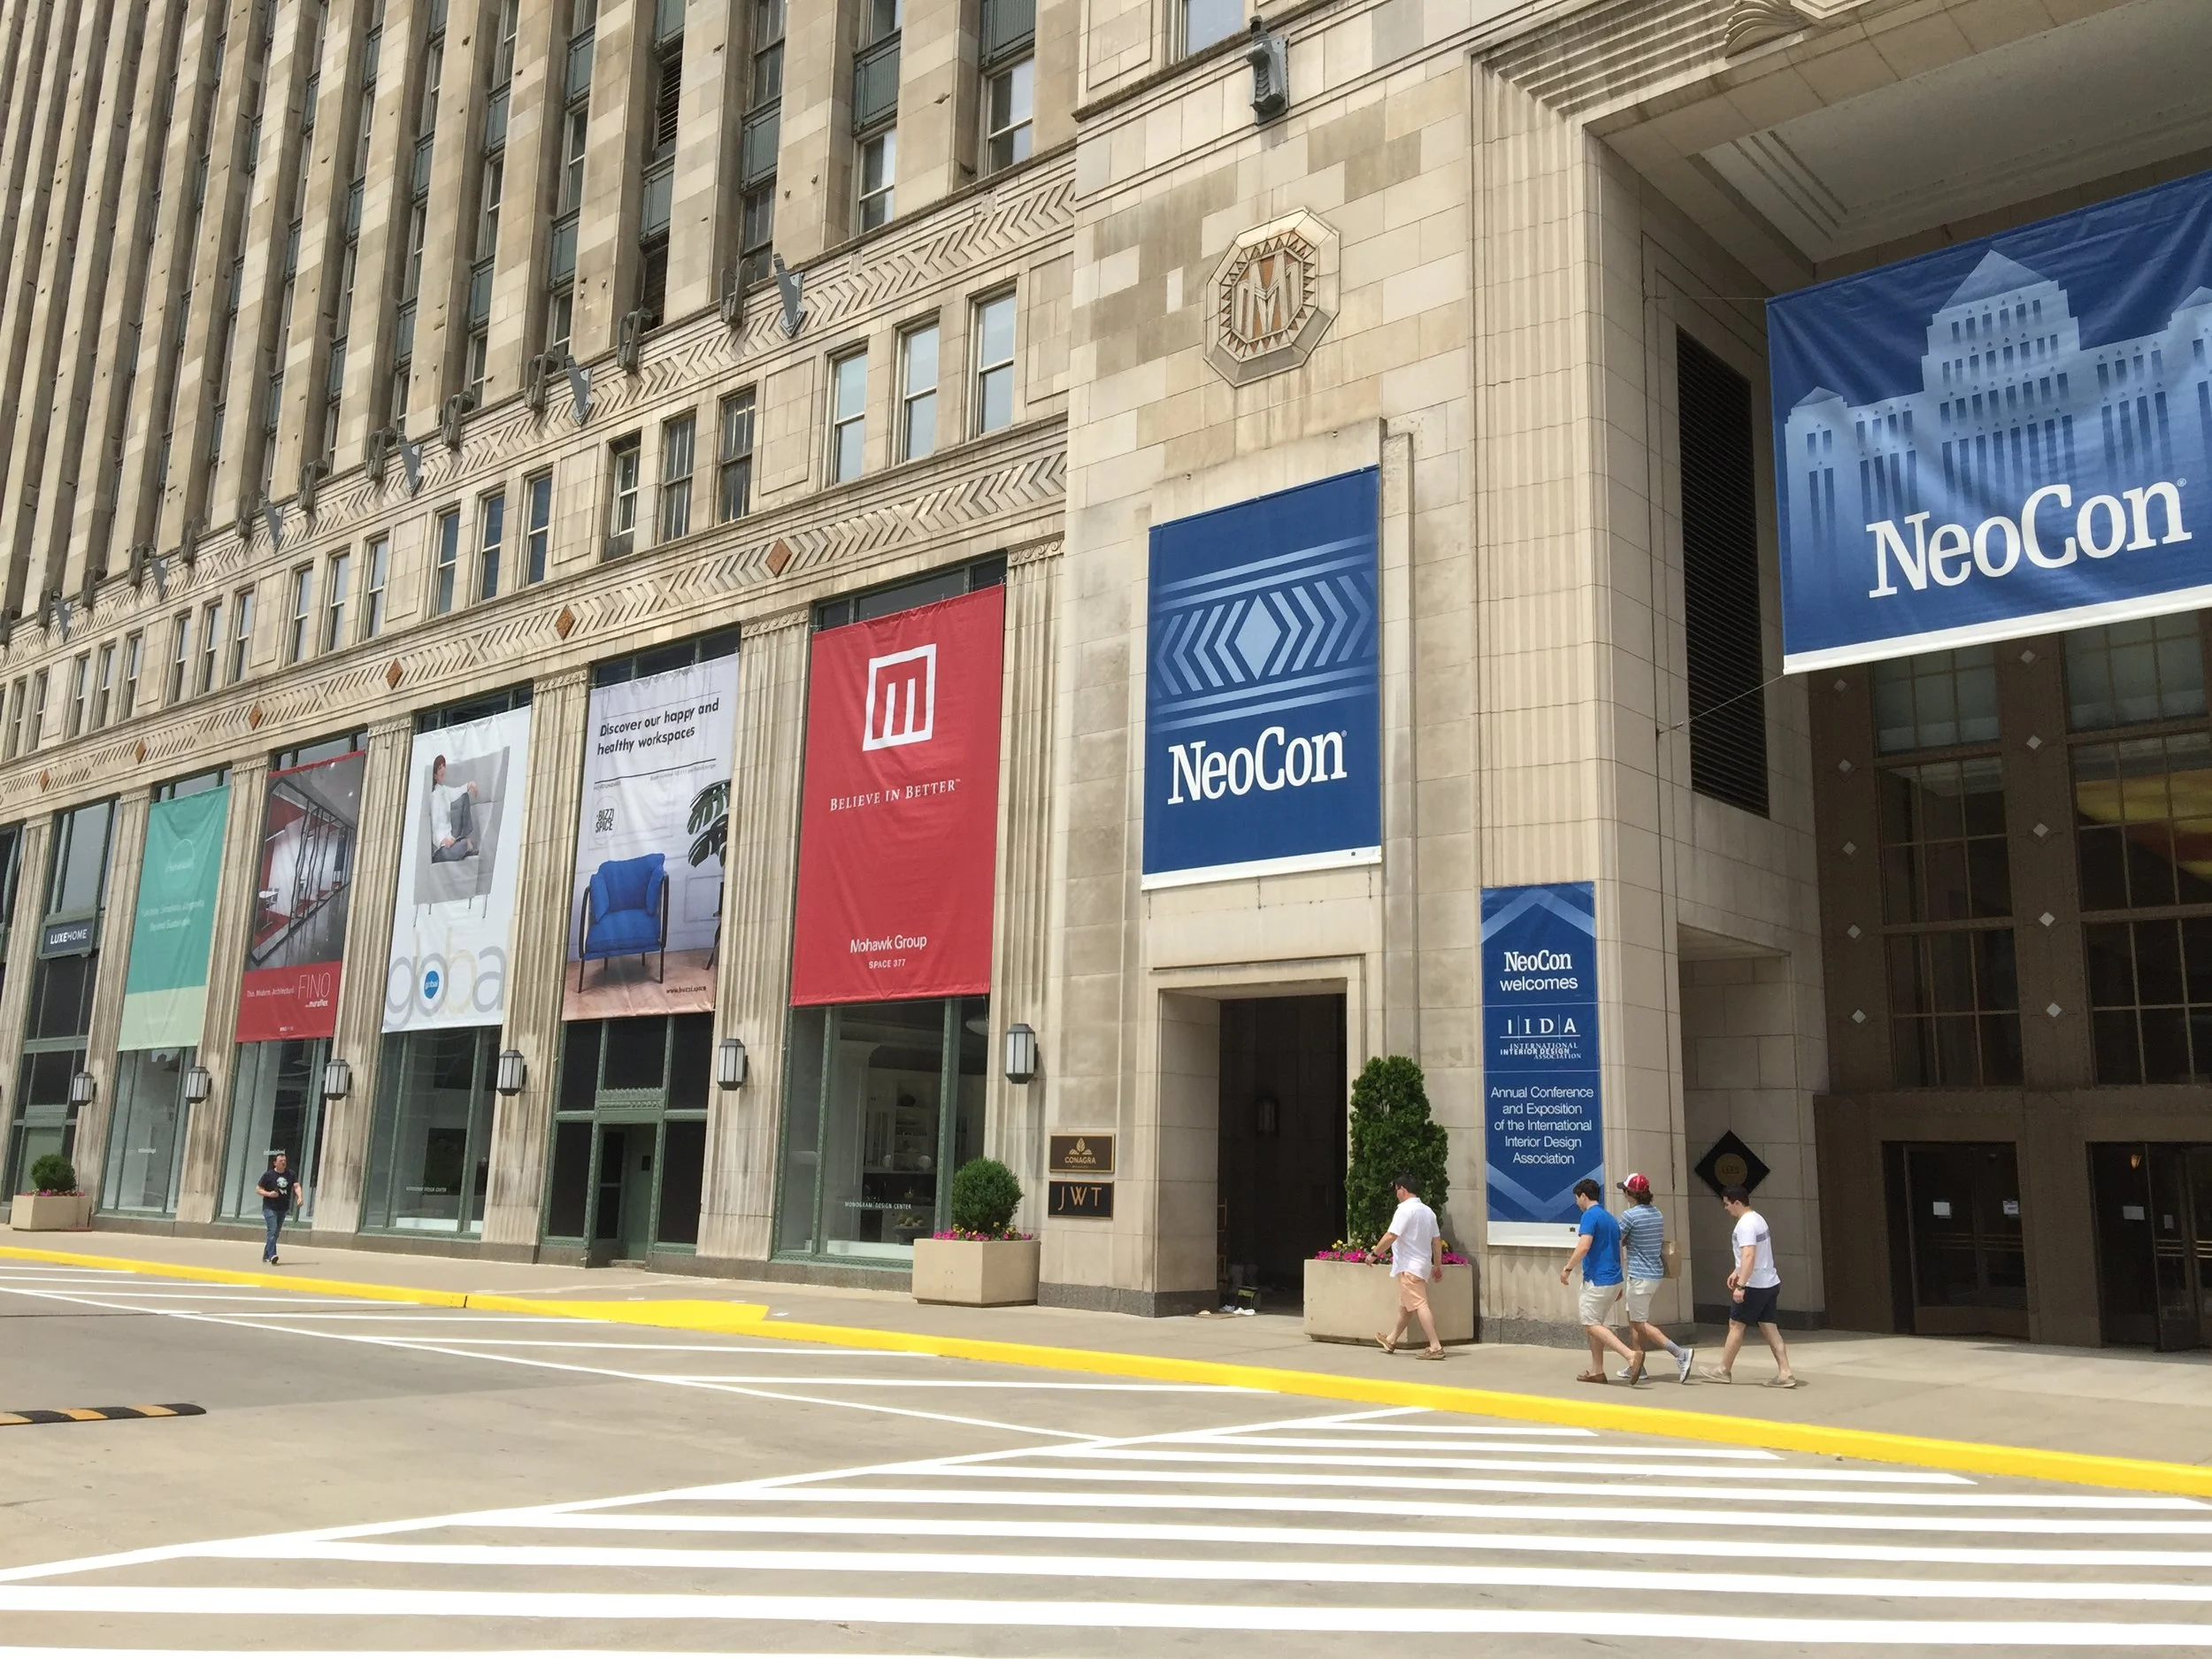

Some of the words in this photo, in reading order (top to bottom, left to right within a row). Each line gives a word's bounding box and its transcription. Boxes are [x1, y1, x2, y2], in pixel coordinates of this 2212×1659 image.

[600, 720, 642, 737] Discover
[644, 716, 661, 728] our
[664, 708, 695, 724] happy
[698, 697, 719, 715] and
[597, 737, 634, 756] healthy
[638, 726, 695, 749] workspaces
[1168, 726, 1348, 804] NeoCon
[830, 792, 880, 811] BELIEVE
[885, 788, 901, 802] IN
[595, 819, 613, 833] SPACE
[850, 936, 893, 953] Mohawk
[895, 934, 927, 950] Group
[869, 960, 891, 969] SPACE
[893, 958, 906, 968] 377
[1504, 949, 1572, 972] NeoCon
[297, 972, 331, 1000] FINO
[1500, 976, 1578, 991] welcomes
[1491, 1087, 1528, 1098] Annual
[1531, 1087, 1594, 1098] Conference
[1502, 1103, 1523, 1114] and
[1526, 1102, 1582, 1117] Exposition
[1494, 1119, 1504, 1131] of
[1507, 1119, 1525, 1131] the
[1527, 1119, 1592, 1131] International
[1505, 1136, 1541, 1148] Interior
[1544, 1136, 1582, 1150] Design
[1513, 1152, 1575, 1164] Association
[1058, 1186, 1102, 1210] JWT
